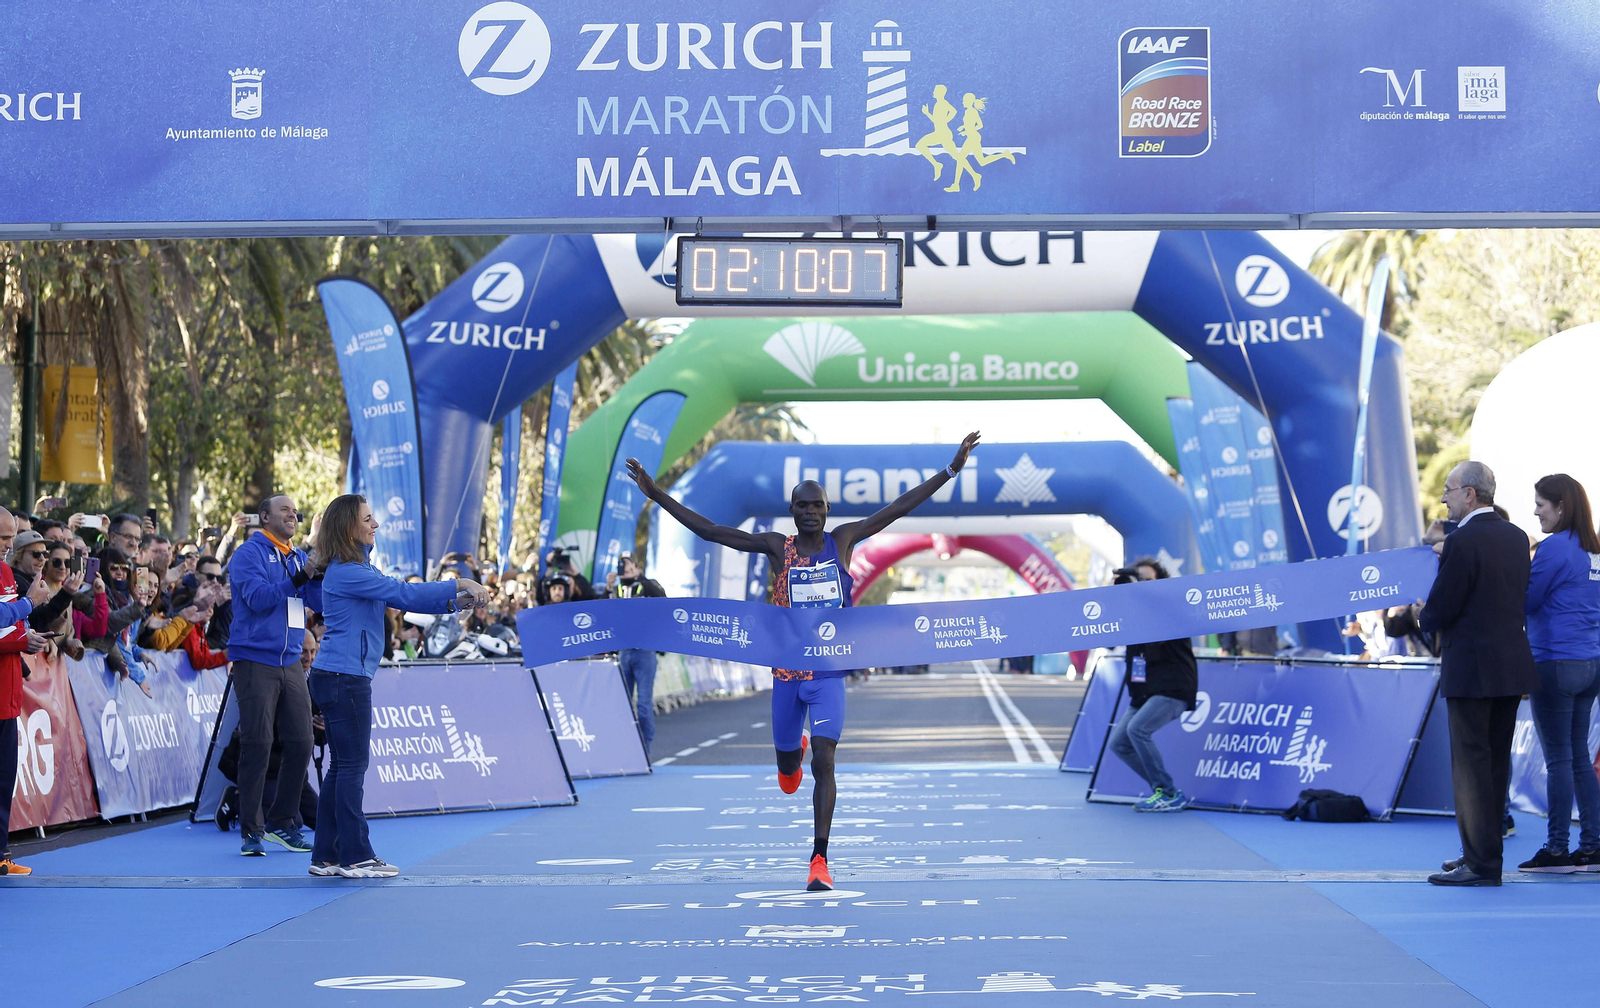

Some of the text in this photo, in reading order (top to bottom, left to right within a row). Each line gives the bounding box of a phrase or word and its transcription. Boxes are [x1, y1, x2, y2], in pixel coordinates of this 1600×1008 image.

[576, 21, 834, 71] ZURICH
[1127, 36, 1190, 54] IAAF
[577, 85, 833, 136] MARATÓN
[1131, 96, 1202, 110] Road Race
[1128, 112, 1202, 129] BRONZE
[1360, 111, 1450, 122] diputación de málaga
[165, 124, 329, 141] Ayuntamiento de Málaga
[1128, 140, 1165, 153] Label
[576, 147, 802, 197] MÁLAGA
[693, 248, 887, 293] 02:10:07
[426, 320, 547, 351] ZURICH
[1203, 316, 1324, 345] ZURICH
[858, 351, 1079, 388] Unicaja Banco
[1206, 585, 1250, 600] ZURICH
[1349, 585, 1399, 602] ZURICH
[1207, 597, 1252, 611] MARATÓN
[692, 611, 730, 625] ZURICH
[933, 616, 975, 629] ZURICH
[1208, 608, 1248, 621] MÁLAGA
[692, 624, 729, 637] MARATÓN
[934, 627, 977, 640] MARATÓN
[1071, 621, 1120, 638] ZURICH
[561, 629, 612, 648] ZURICH
[692, 633, 723, 646] MÁLAGA
[936, 637, 973, 650] MÁLAGA
[804, 644, 852, 658] ZURICH
[1212, 702, 1294, 727] ZURICH
[128, 712, 180, 751] ZURICH
[370, 732, 445, 757] MARATÓN
[1204, 731, 1283, 756] MARATÓN
[376, 760, 446, 784] MÁLAGA
[1195, 759, 1262, 781] MÁLAGA
[607, 899, 982, 911] ZURICH
[504, 973, 928, 988] ZURICH
[493, 984, 926, 997] MARATÓN
[481, 994, 870, 1006] MÁLAGA
